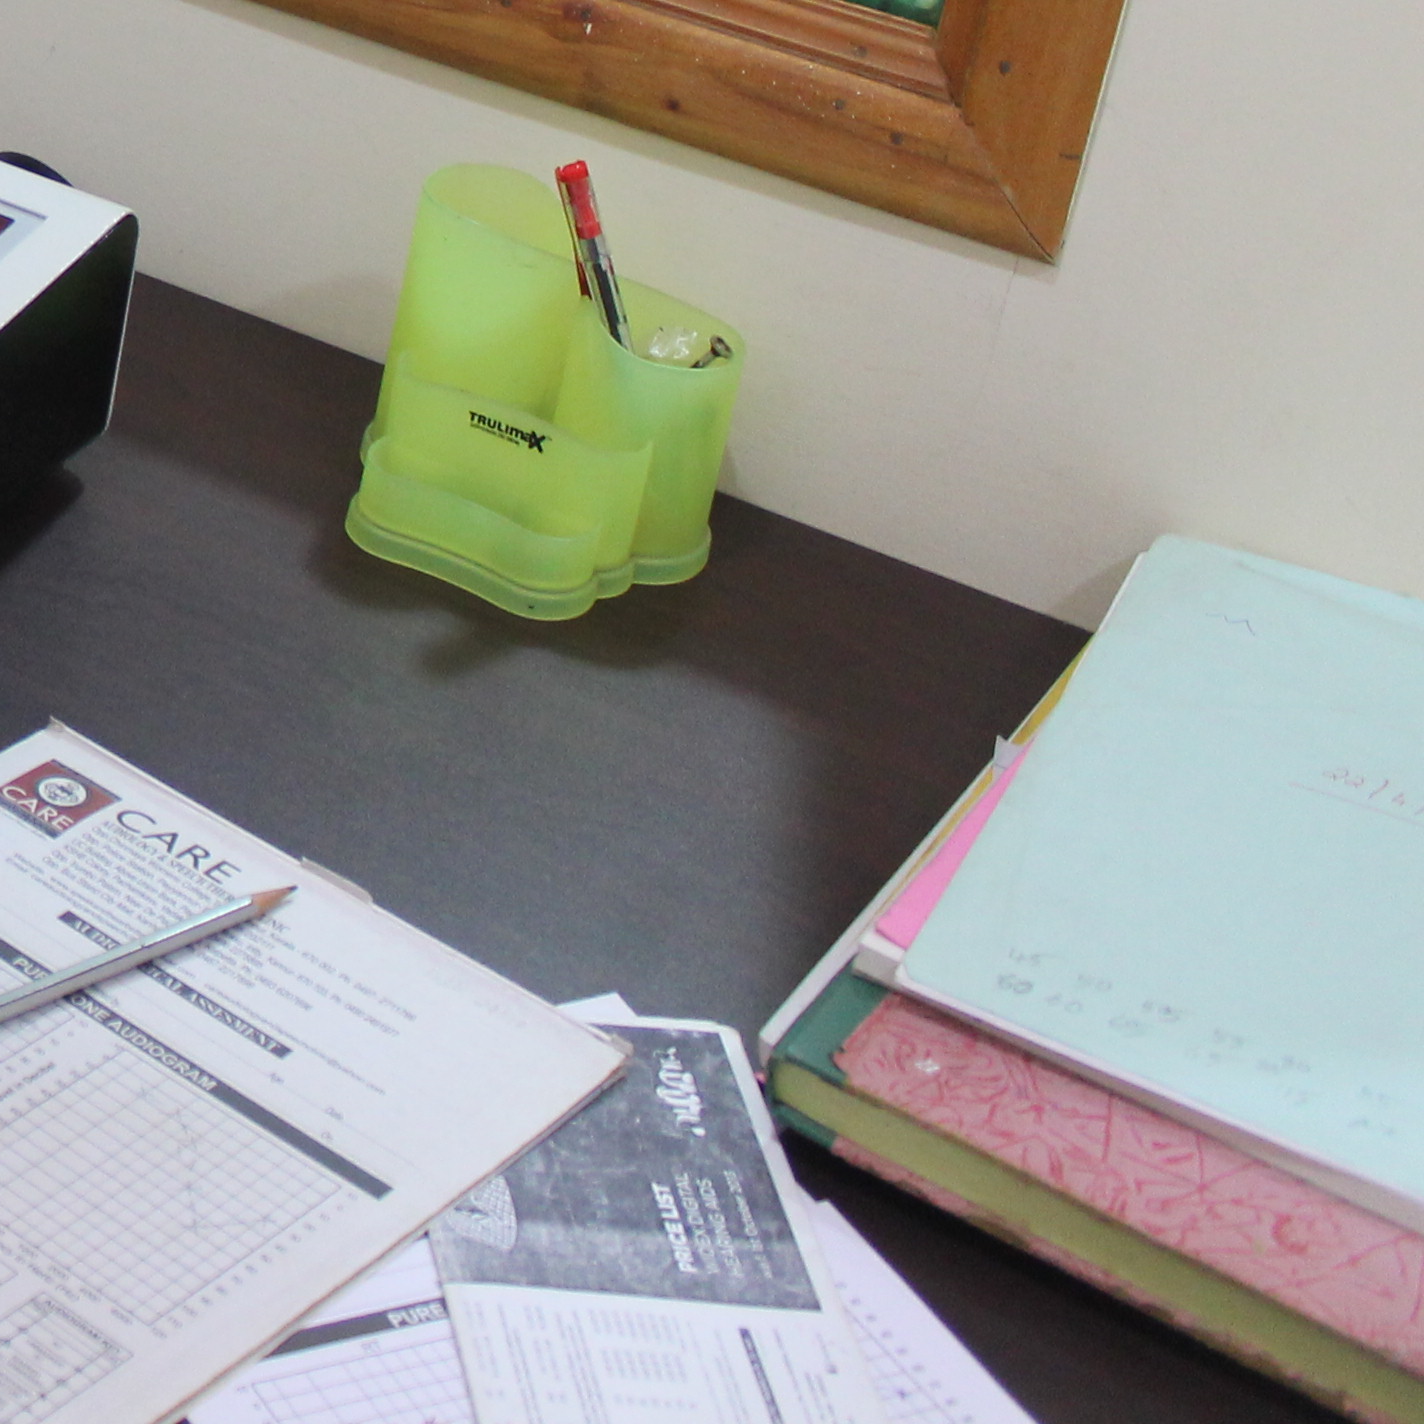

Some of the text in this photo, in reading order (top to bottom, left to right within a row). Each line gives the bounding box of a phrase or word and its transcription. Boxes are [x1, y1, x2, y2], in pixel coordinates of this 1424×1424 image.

[98, 819, 159, 856] AUDIOLOGY
[165, 858, 214, 888] SPEECH
[110, 804, 242, 885] CARE
[104, 1017, 220, 1092] AUDIOGRAM
[183, 990, 282, 1053] ASSESMENT
[651, 1181, 699, 1274] PRICE LIST
[388, 1303, 450, 1328] PURE
